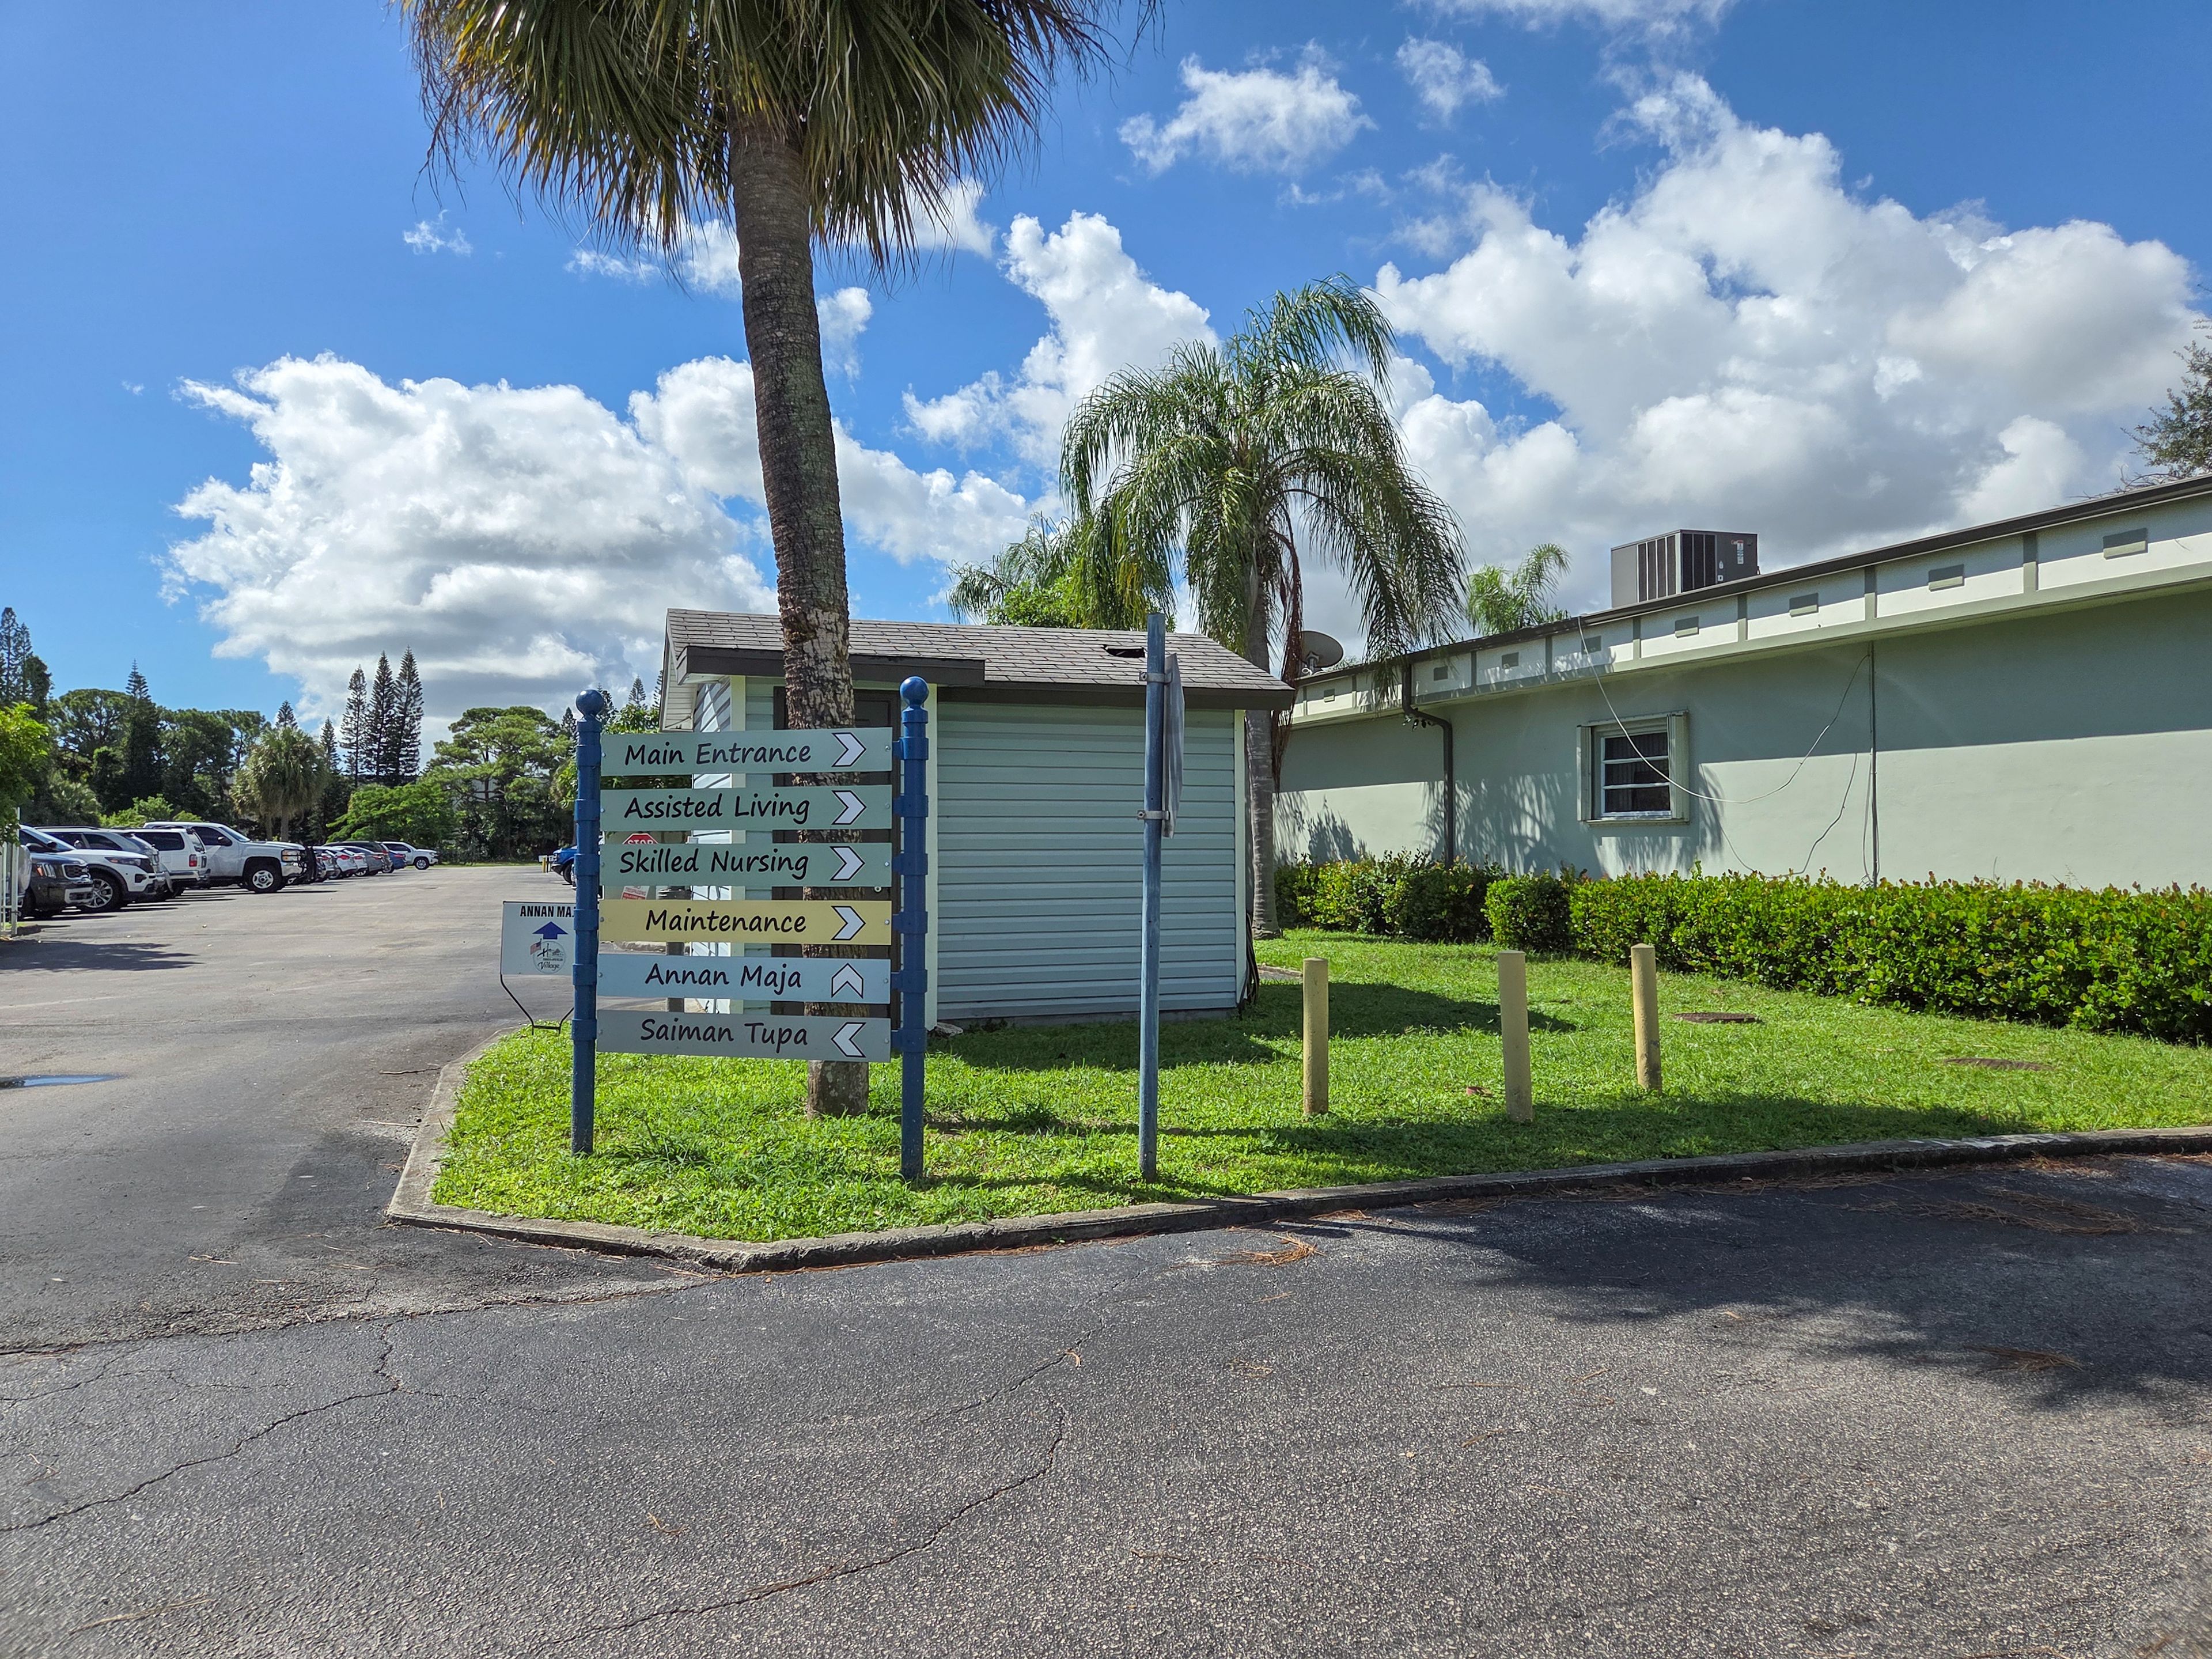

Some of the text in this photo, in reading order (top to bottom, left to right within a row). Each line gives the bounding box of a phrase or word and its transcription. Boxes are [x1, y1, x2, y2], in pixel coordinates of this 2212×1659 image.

[624, 741, 812, 766] Main Entrance
[624, 793, 810, 825] Assisted Living
[619, 847, 809, 880] Skilled Nursing
[520, 906, 554, 917] ANNAN
[645, 907, 807, 933] Maintenance
[537, 961, 560, 971] Village
[645, 963, 802, 995] Annan Maja
[640, 1017, 808, 1054] Saiman Tupa
